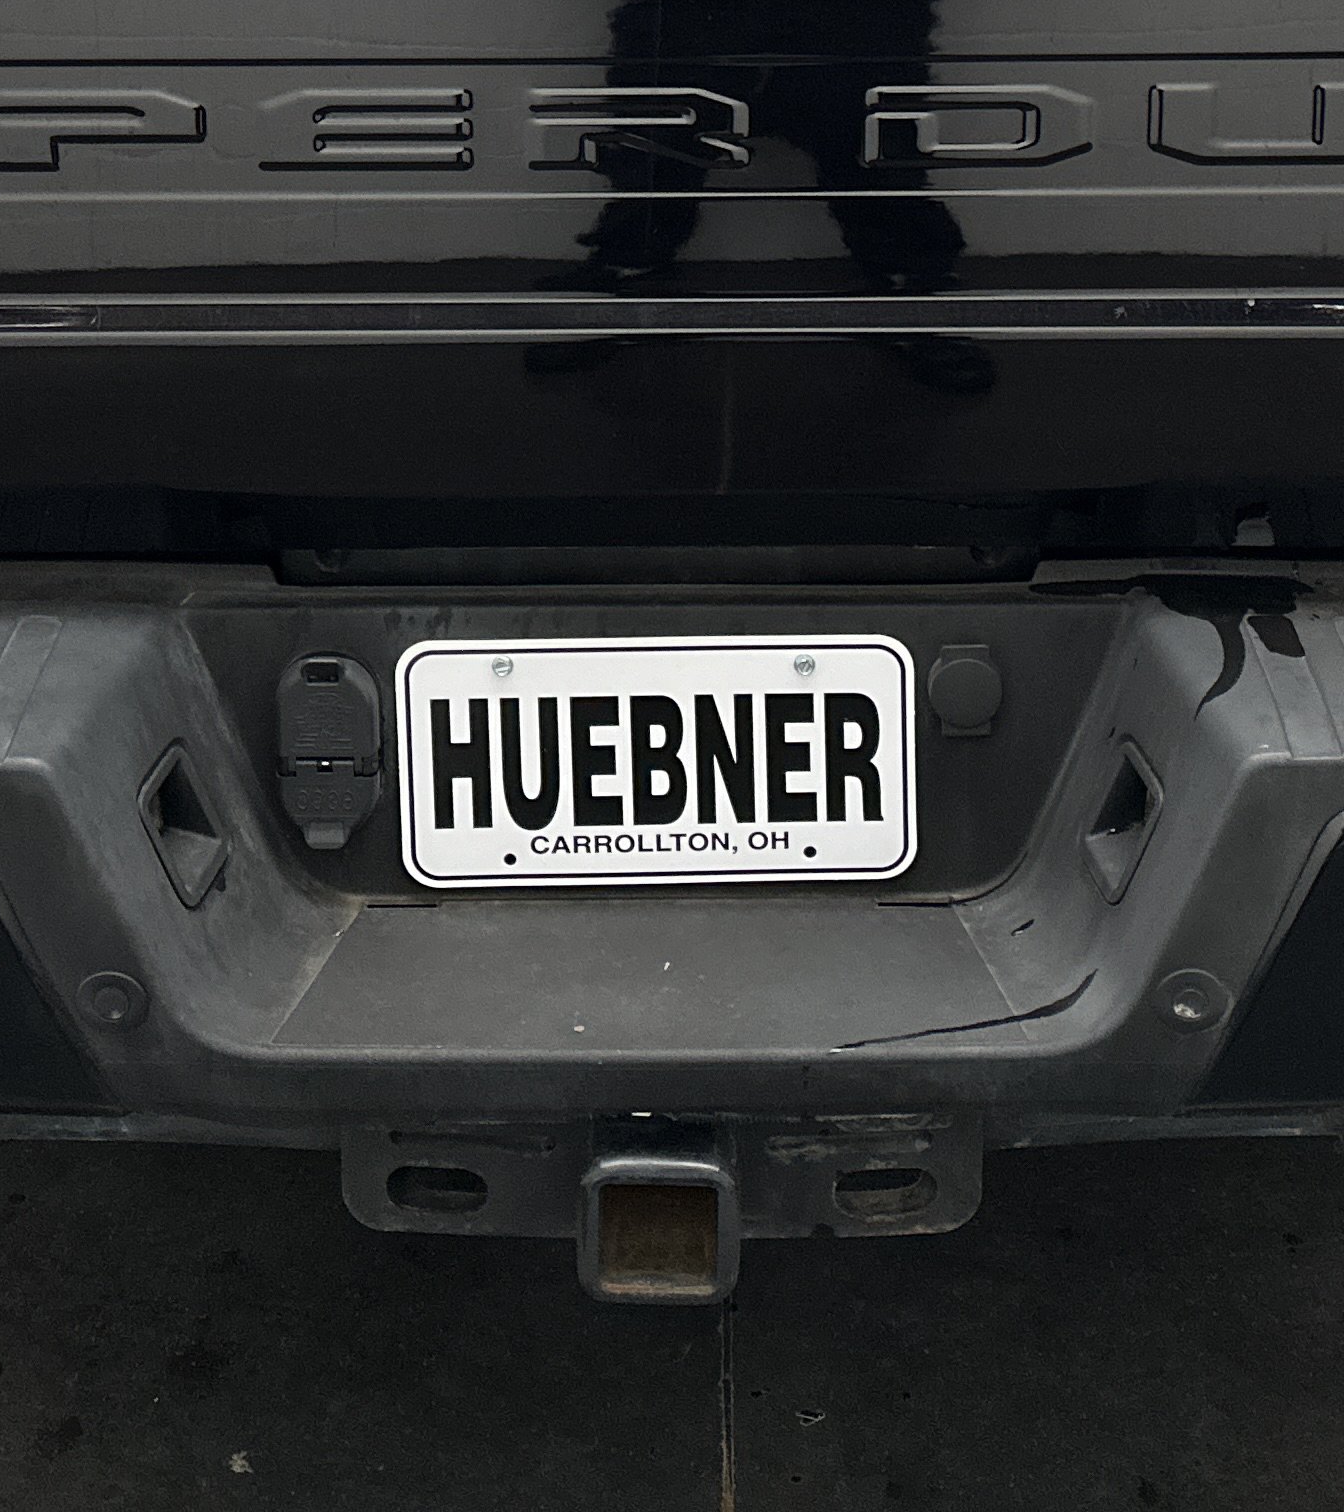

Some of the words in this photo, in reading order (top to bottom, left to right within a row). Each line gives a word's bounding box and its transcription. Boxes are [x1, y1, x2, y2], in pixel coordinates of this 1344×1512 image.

[429, 692, 884, 831] HUEBNER
[530, 832, 739, 856] CARROLLTON,
[748, 831, 790, 851] OH
